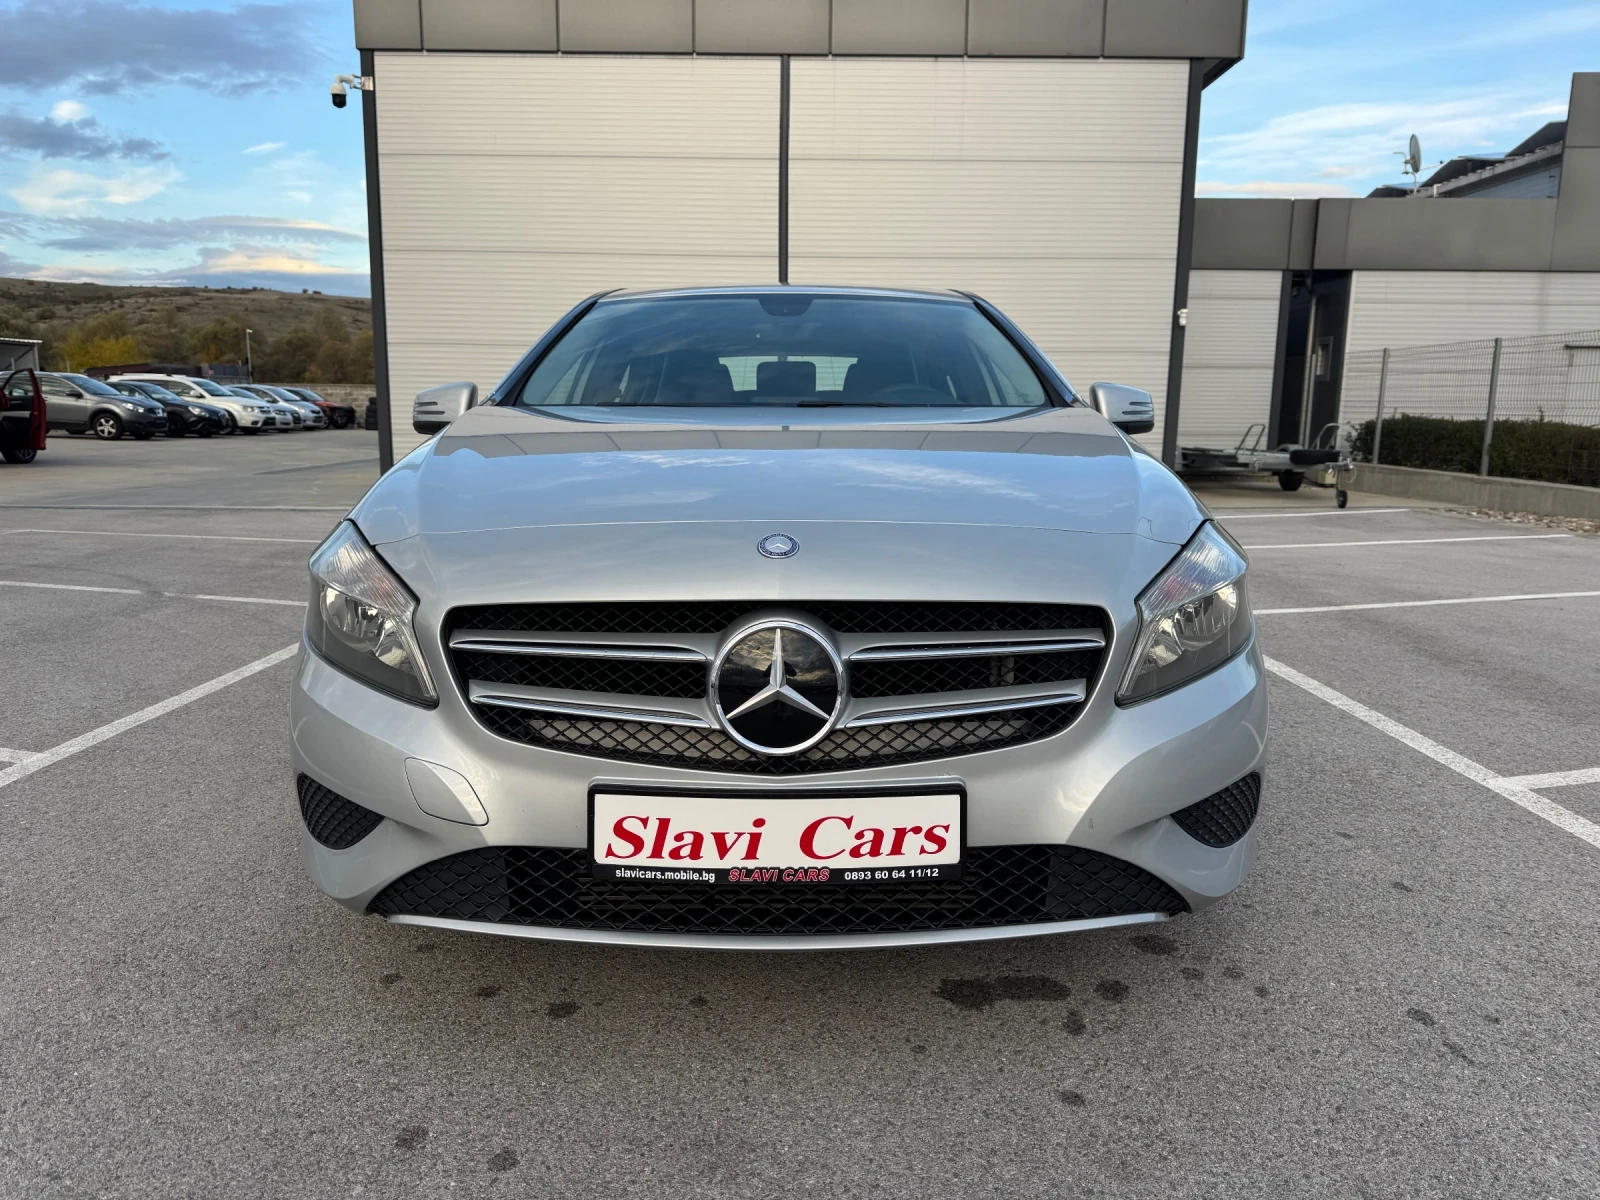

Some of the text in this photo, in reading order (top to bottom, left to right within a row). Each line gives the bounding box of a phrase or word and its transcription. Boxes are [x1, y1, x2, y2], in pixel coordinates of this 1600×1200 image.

[604, 815, 951, 861] Slavi Cars
[615, 867, 716, 883] slavicars.mobile.bg
[728, 868, 831, 882] SLAVI CARS
[844, 868, 939, 881] 0893 60 64 11/12
